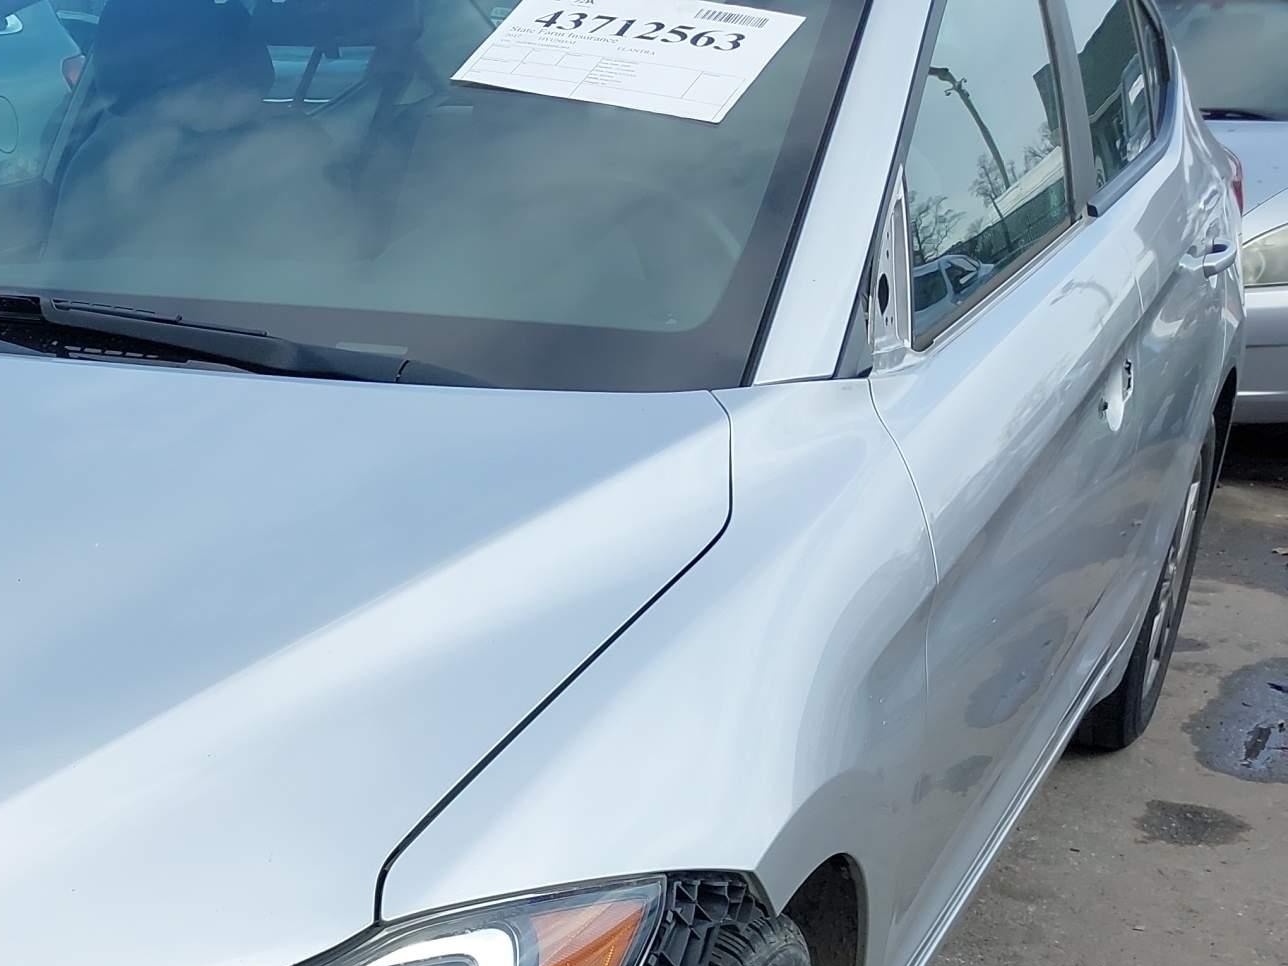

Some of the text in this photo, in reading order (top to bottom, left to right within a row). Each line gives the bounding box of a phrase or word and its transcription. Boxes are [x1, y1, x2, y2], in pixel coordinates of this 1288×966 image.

[511, 25, 535, 34] State
[537, 28, 566, 37] Farm
[568, 31, 620, 44] Insurance
[534, 9, 746, 51] 43712563
